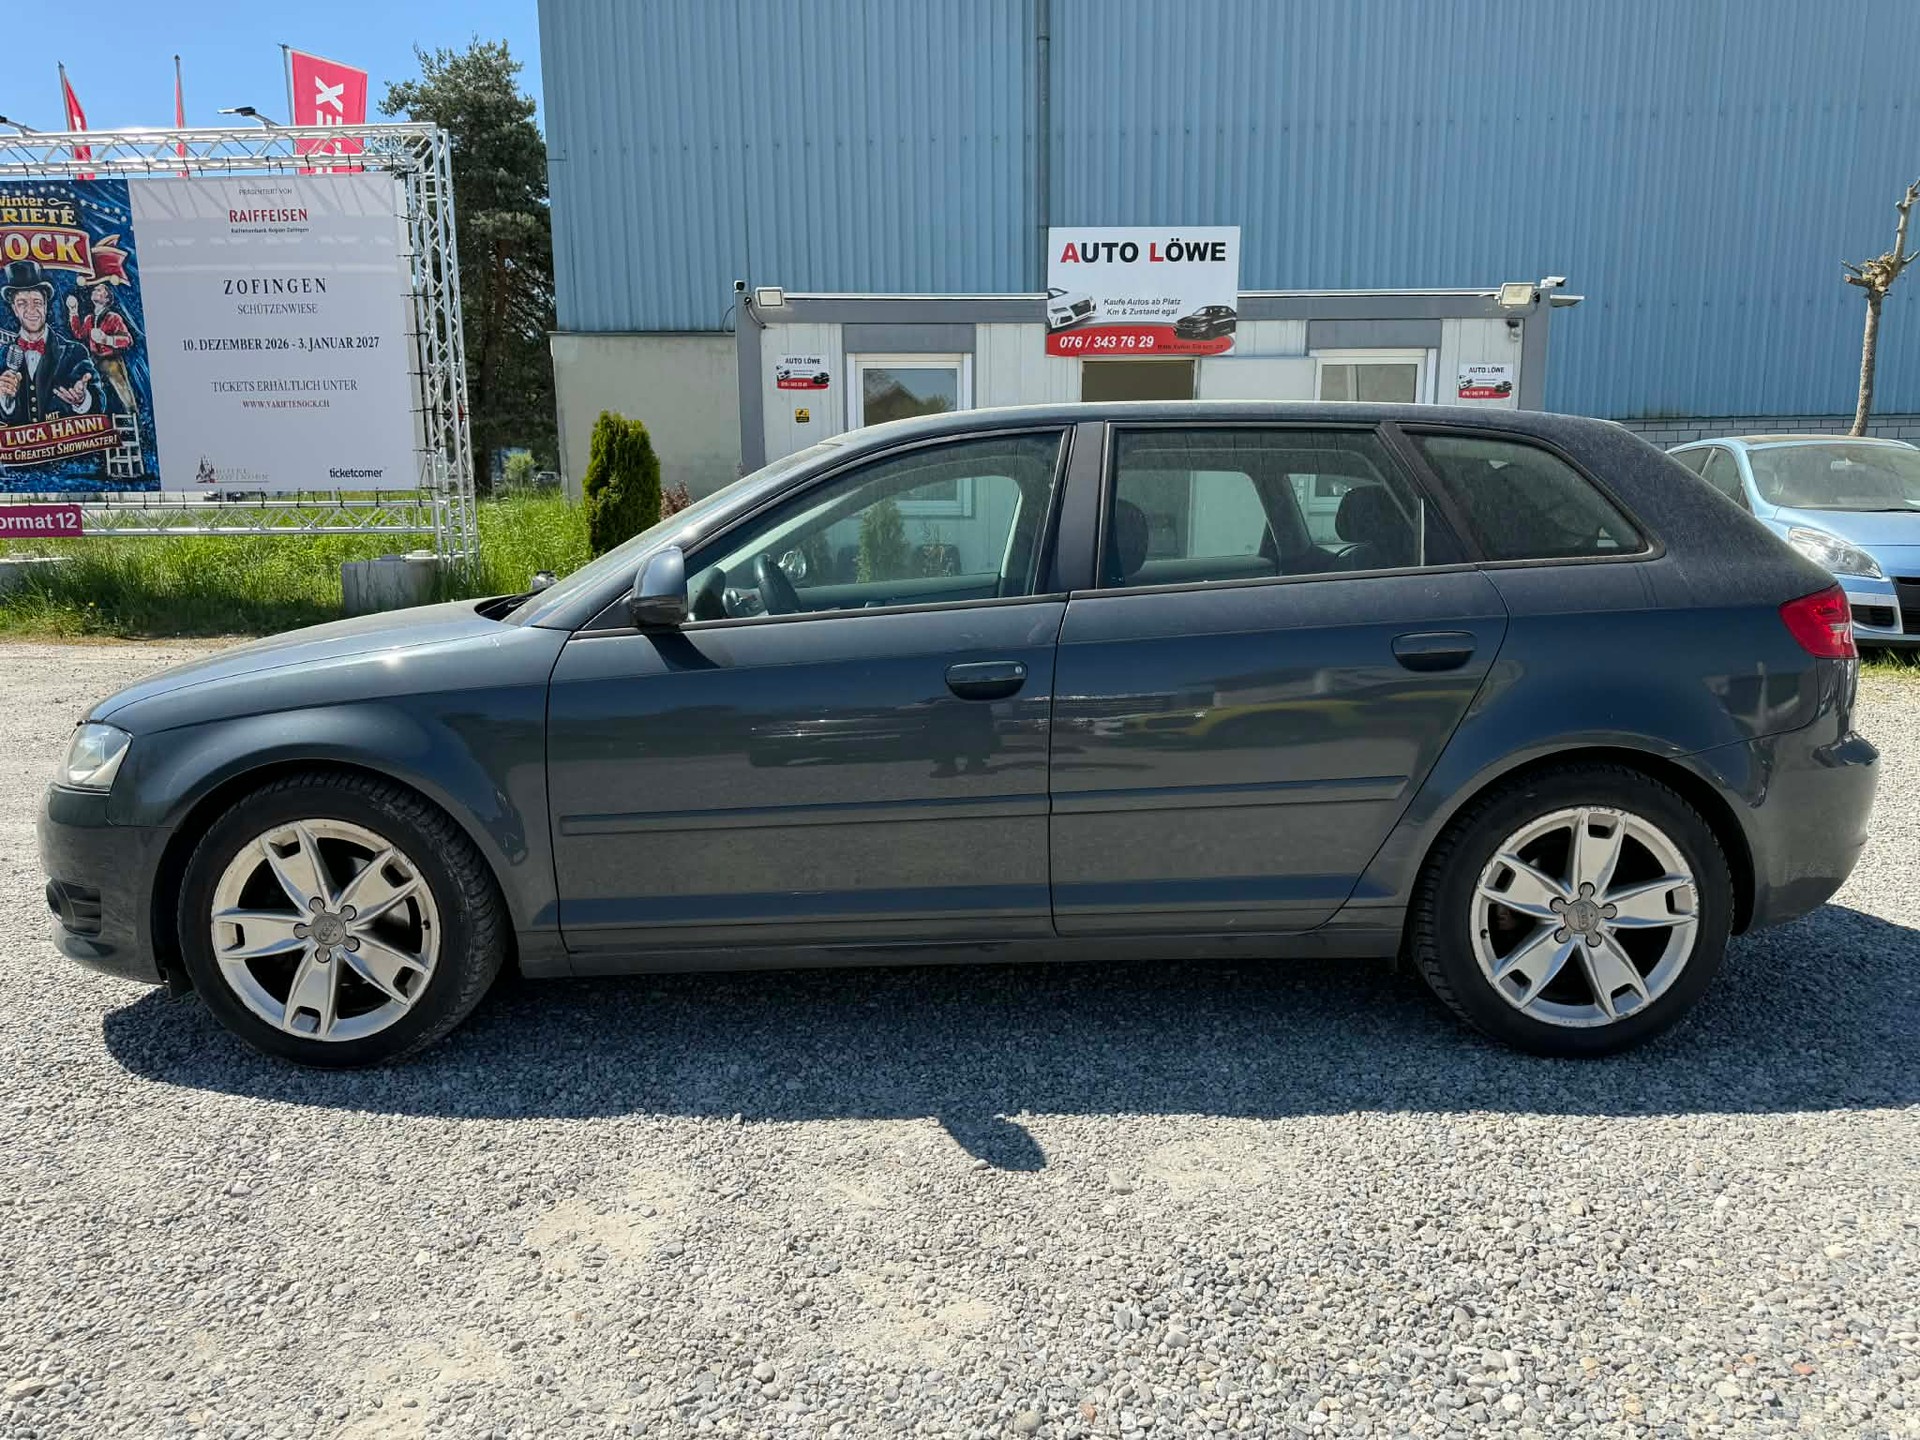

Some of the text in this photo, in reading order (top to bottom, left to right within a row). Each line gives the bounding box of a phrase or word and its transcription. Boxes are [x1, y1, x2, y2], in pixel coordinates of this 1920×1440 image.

[0, 205, 77, 225] RIETÉ
[229, 208, 308, 223] RAIFFEISEN
[0, 233, 84, 263] OCK
[1060, 238, 1226, 263] AUTO LÖWE
[223, 277, 327, 295] ZOFINGEN
[237, 302, 318, 315] SCHÜTZENWIESE
[1103, 298, 1182, 306] Kaufe Autos ab Platz
[1106, 308, 1119, 316] Km
[1128, 308, 1160, 316] Zustand
[1161, 307, 1178, 317] egal
[182, 338, 197, 351] 10.
[199, 338, 263, 351] DEZEMBER
[264, 337, 290, 350] 2026
[307, 337, 354, 352] JANUAR
[355, 336, 380, 349] 2027
[1059, 336, 1083, 348] 076
[1094, 336, 1117, 348] 343
[1120, 336, 1136, 348] 76
[1139, 335, 1154, 348] 29
[1469, 366, 1486, 374] AUTO
[211, 379, 358, 392] TICKETS ERHÄLTLICH UNTER
[45, 411, 60, 421] MIT
[5, 417, 105, 446] LUCA HÄNNI
[14, 446, 55, 461] GREATEST
[57, 434, 118, 454] SHOWMASTER!
[329, 467, 384, 479] ticketcorner
[56, 512, 78, 529] 12
